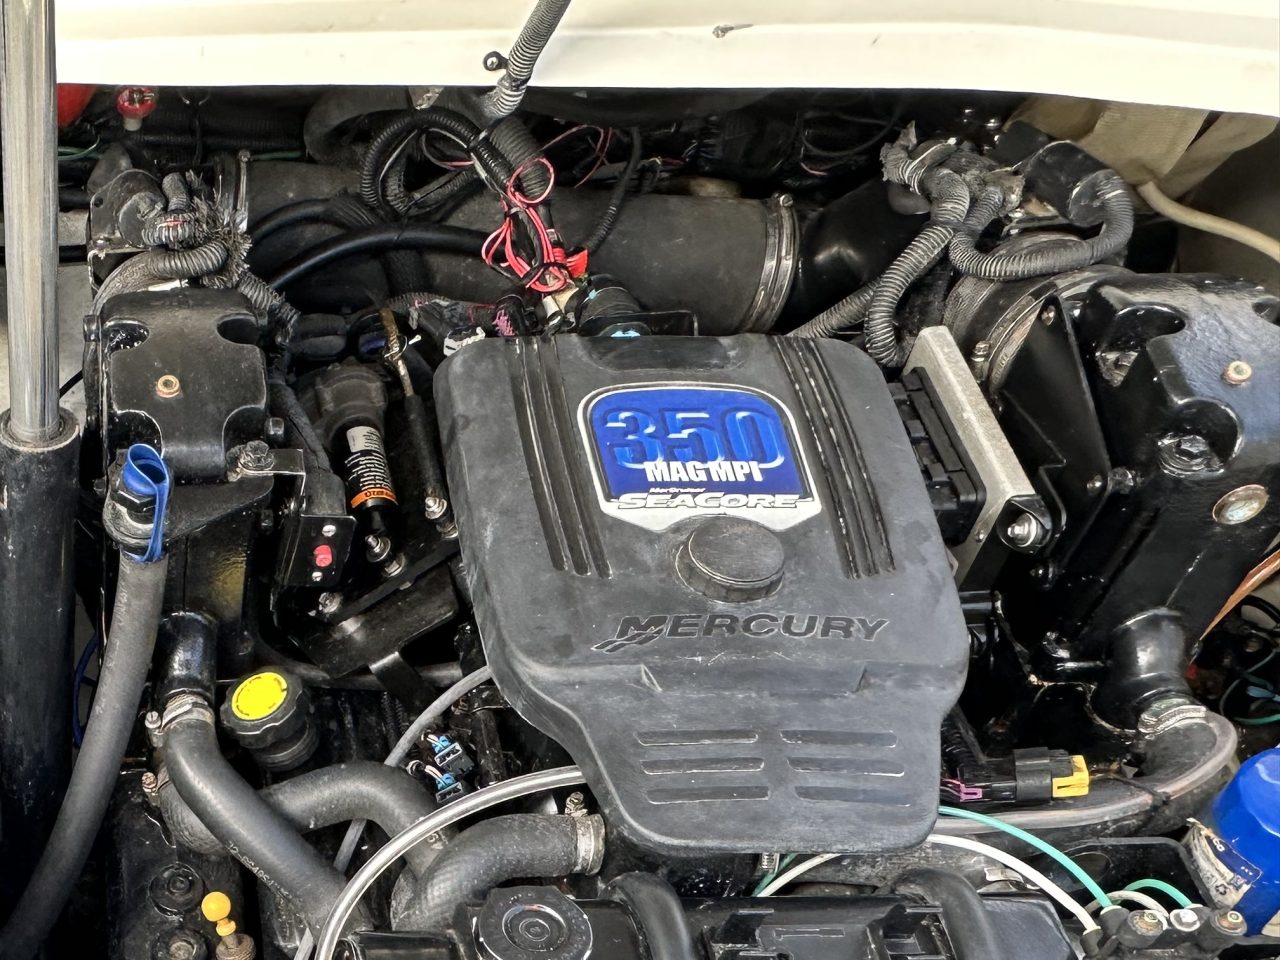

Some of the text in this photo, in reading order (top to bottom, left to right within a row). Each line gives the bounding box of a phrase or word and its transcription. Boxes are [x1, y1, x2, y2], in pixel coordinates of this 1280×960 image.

[605, 408, 785, 469] 350
[643, 460, 764, 482] MAG MPI
[598, 612, 889, 649] MERCURY
